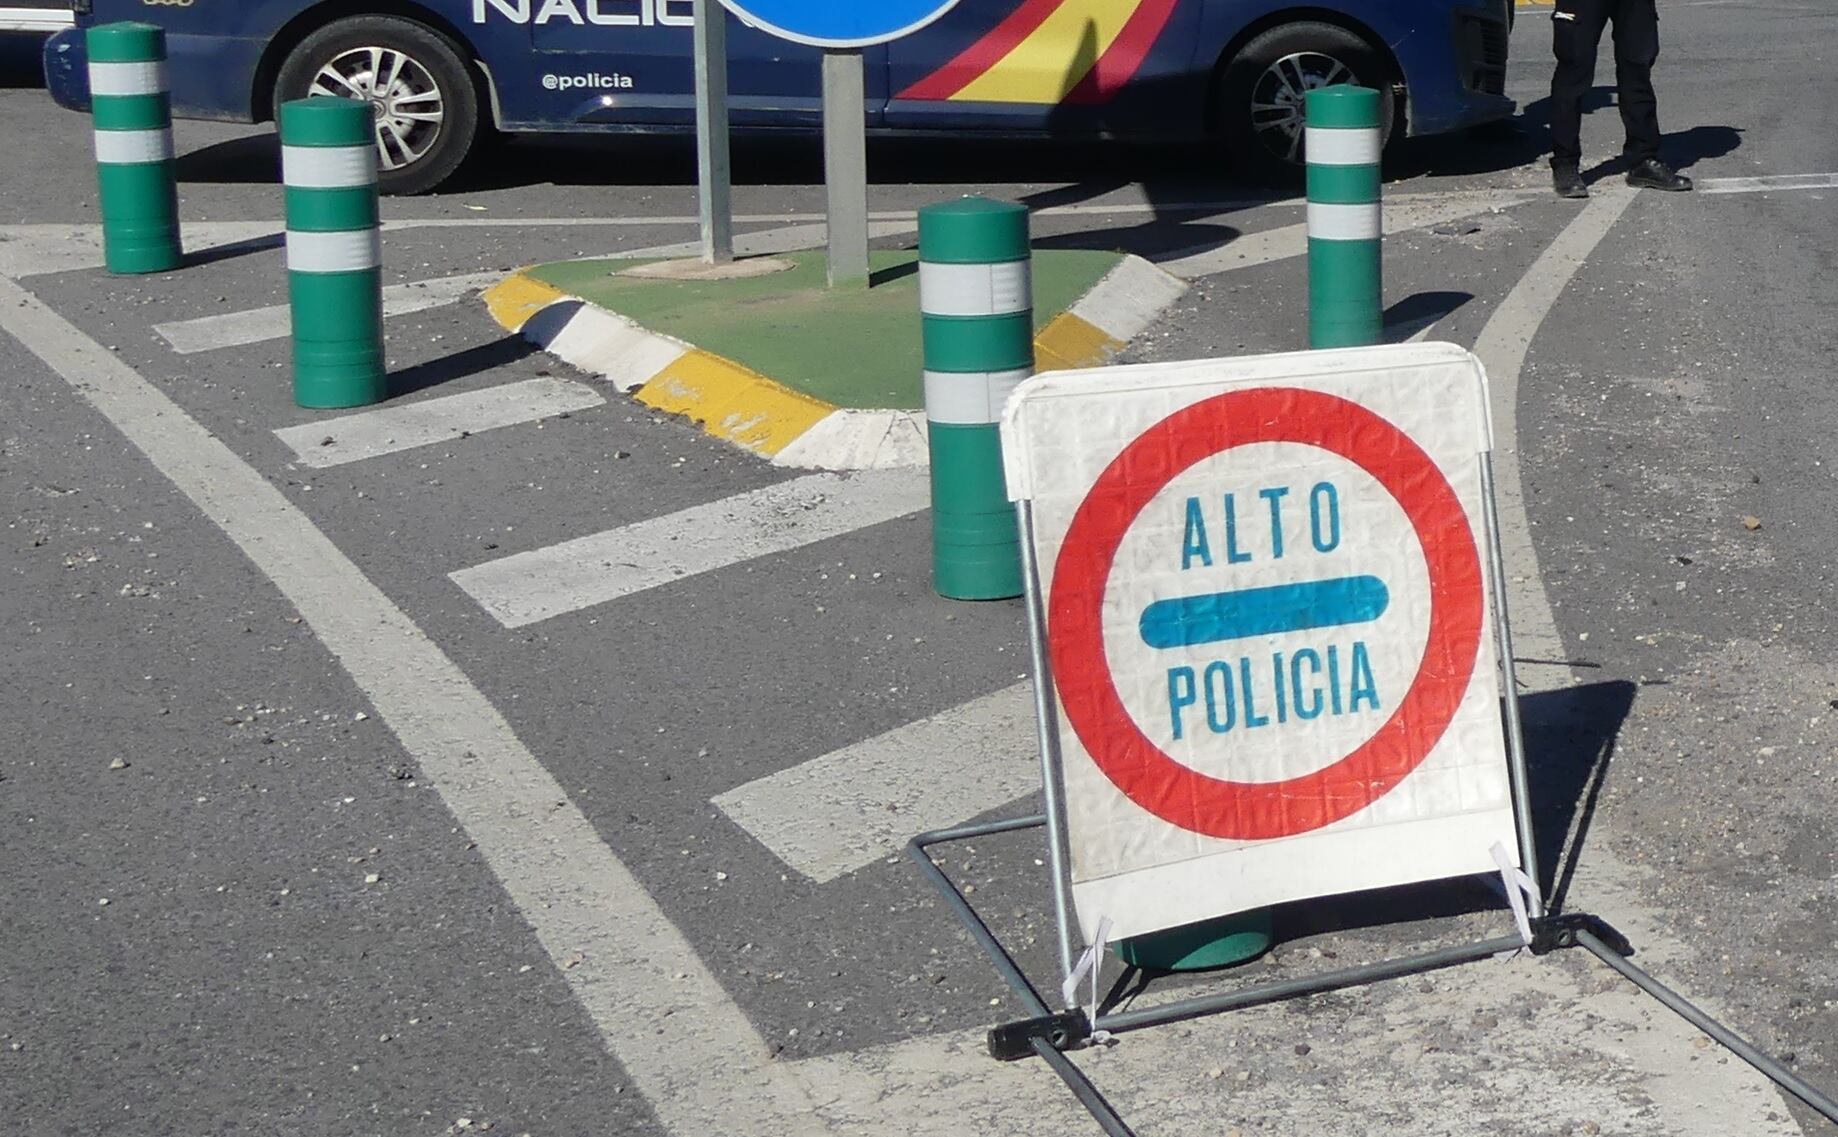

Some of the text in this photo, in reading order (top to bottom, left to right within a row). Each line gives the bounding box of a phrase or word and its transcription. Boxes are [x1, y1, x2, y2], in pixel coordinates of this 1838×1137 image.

[542, 73, 634, 90] @policia
[1182, 481, 1340, 570] ALTO
[1168, 641, 1380, 740] POLICIA
